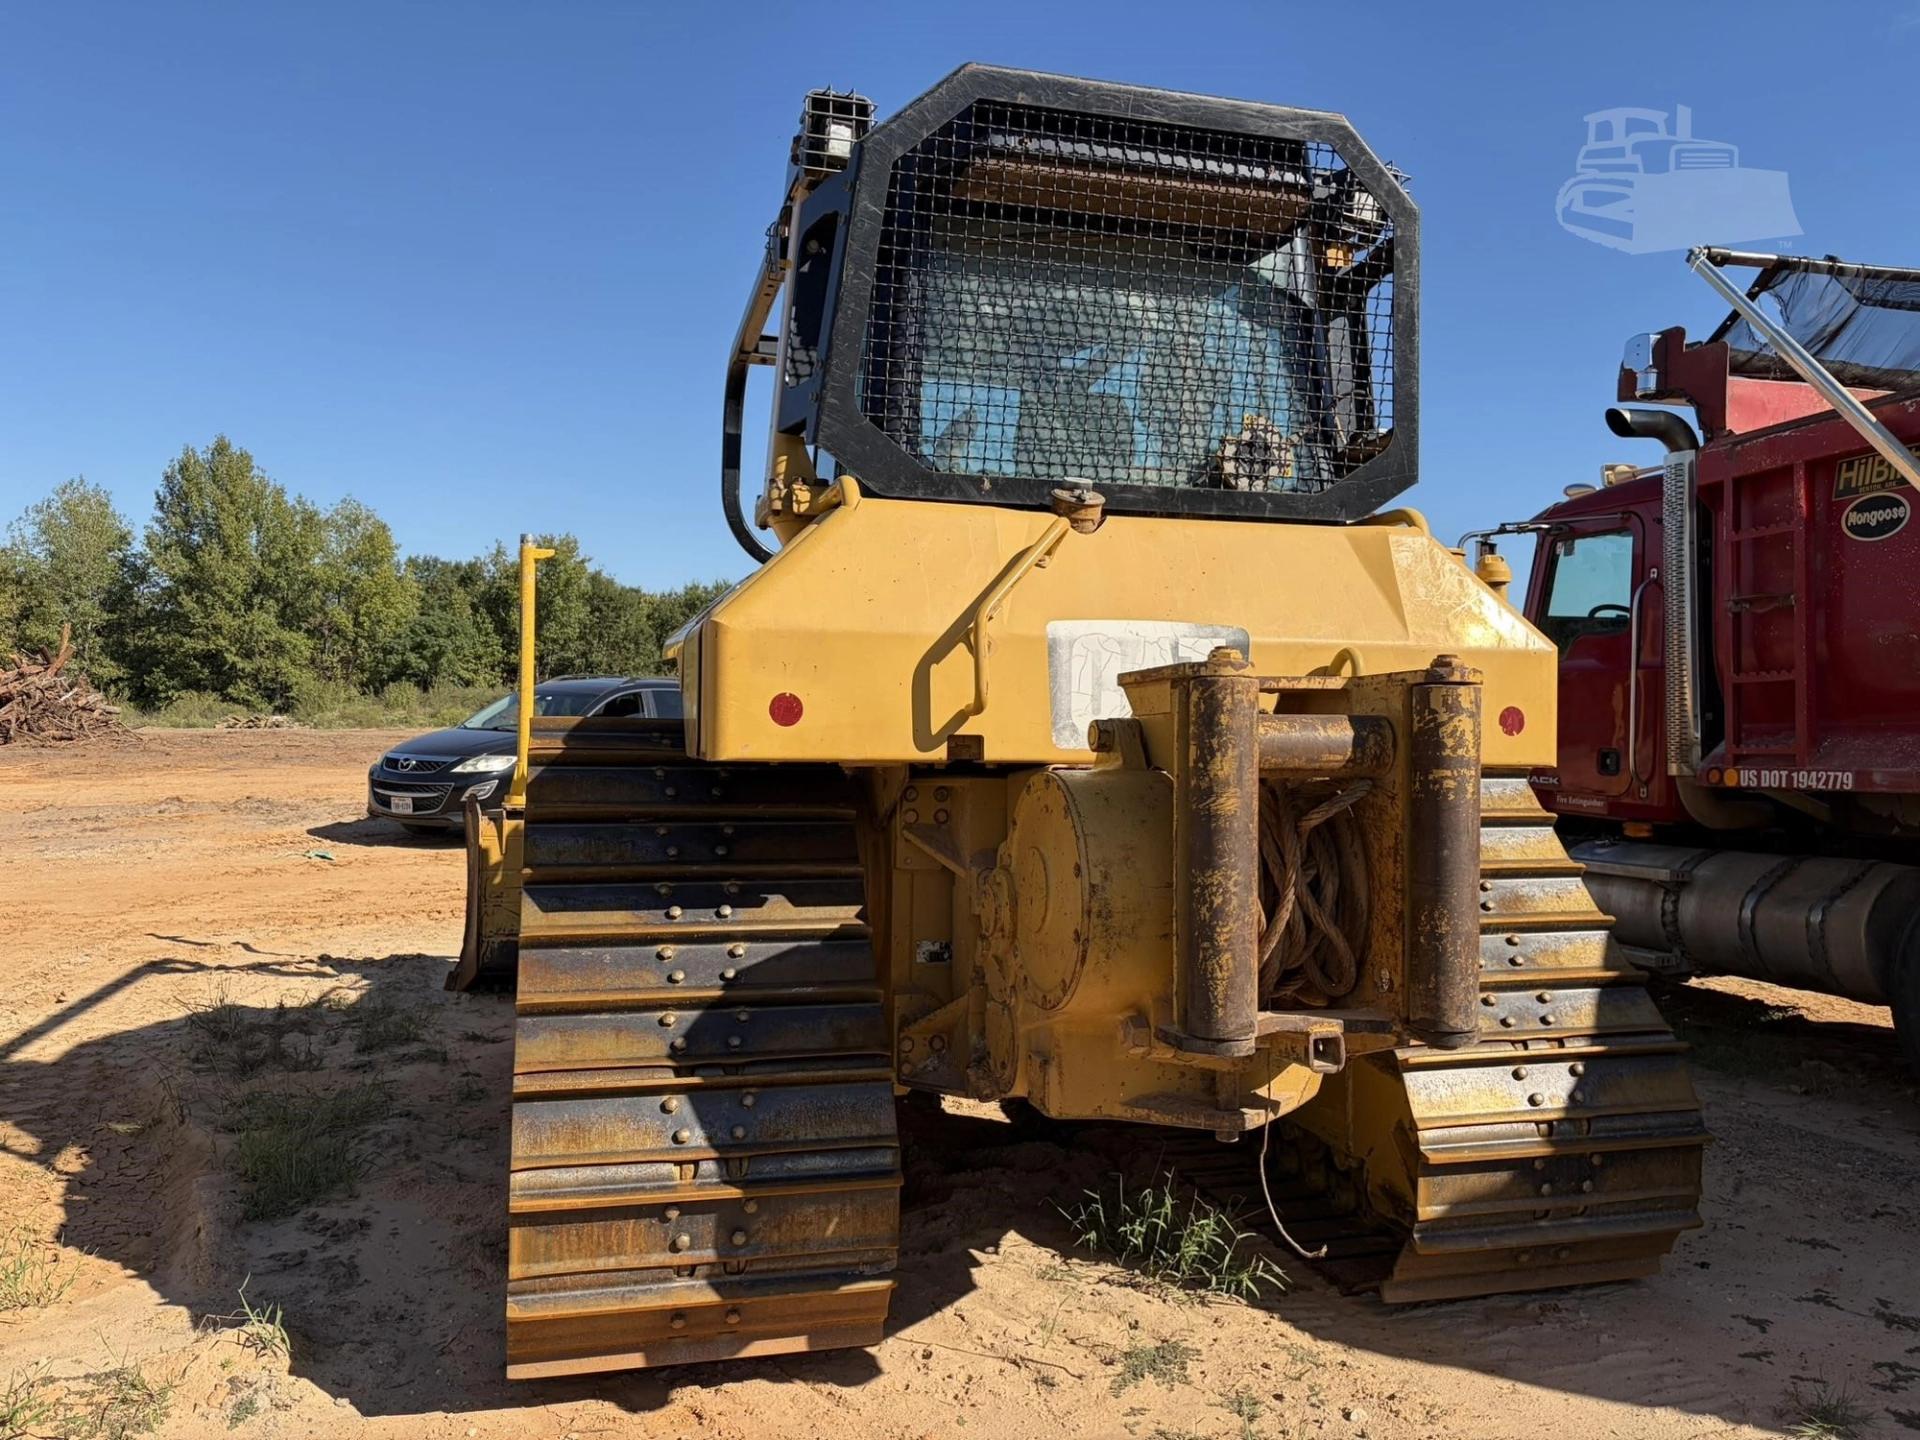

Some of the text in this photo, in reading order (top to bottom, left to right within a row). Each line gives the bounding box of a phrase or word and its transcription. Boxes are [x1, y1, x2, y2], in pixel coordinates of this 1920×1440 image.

[1847, 506, 1906, 526] Mongoose
[1740, 770, 1853, 790] US DOT 1942779
